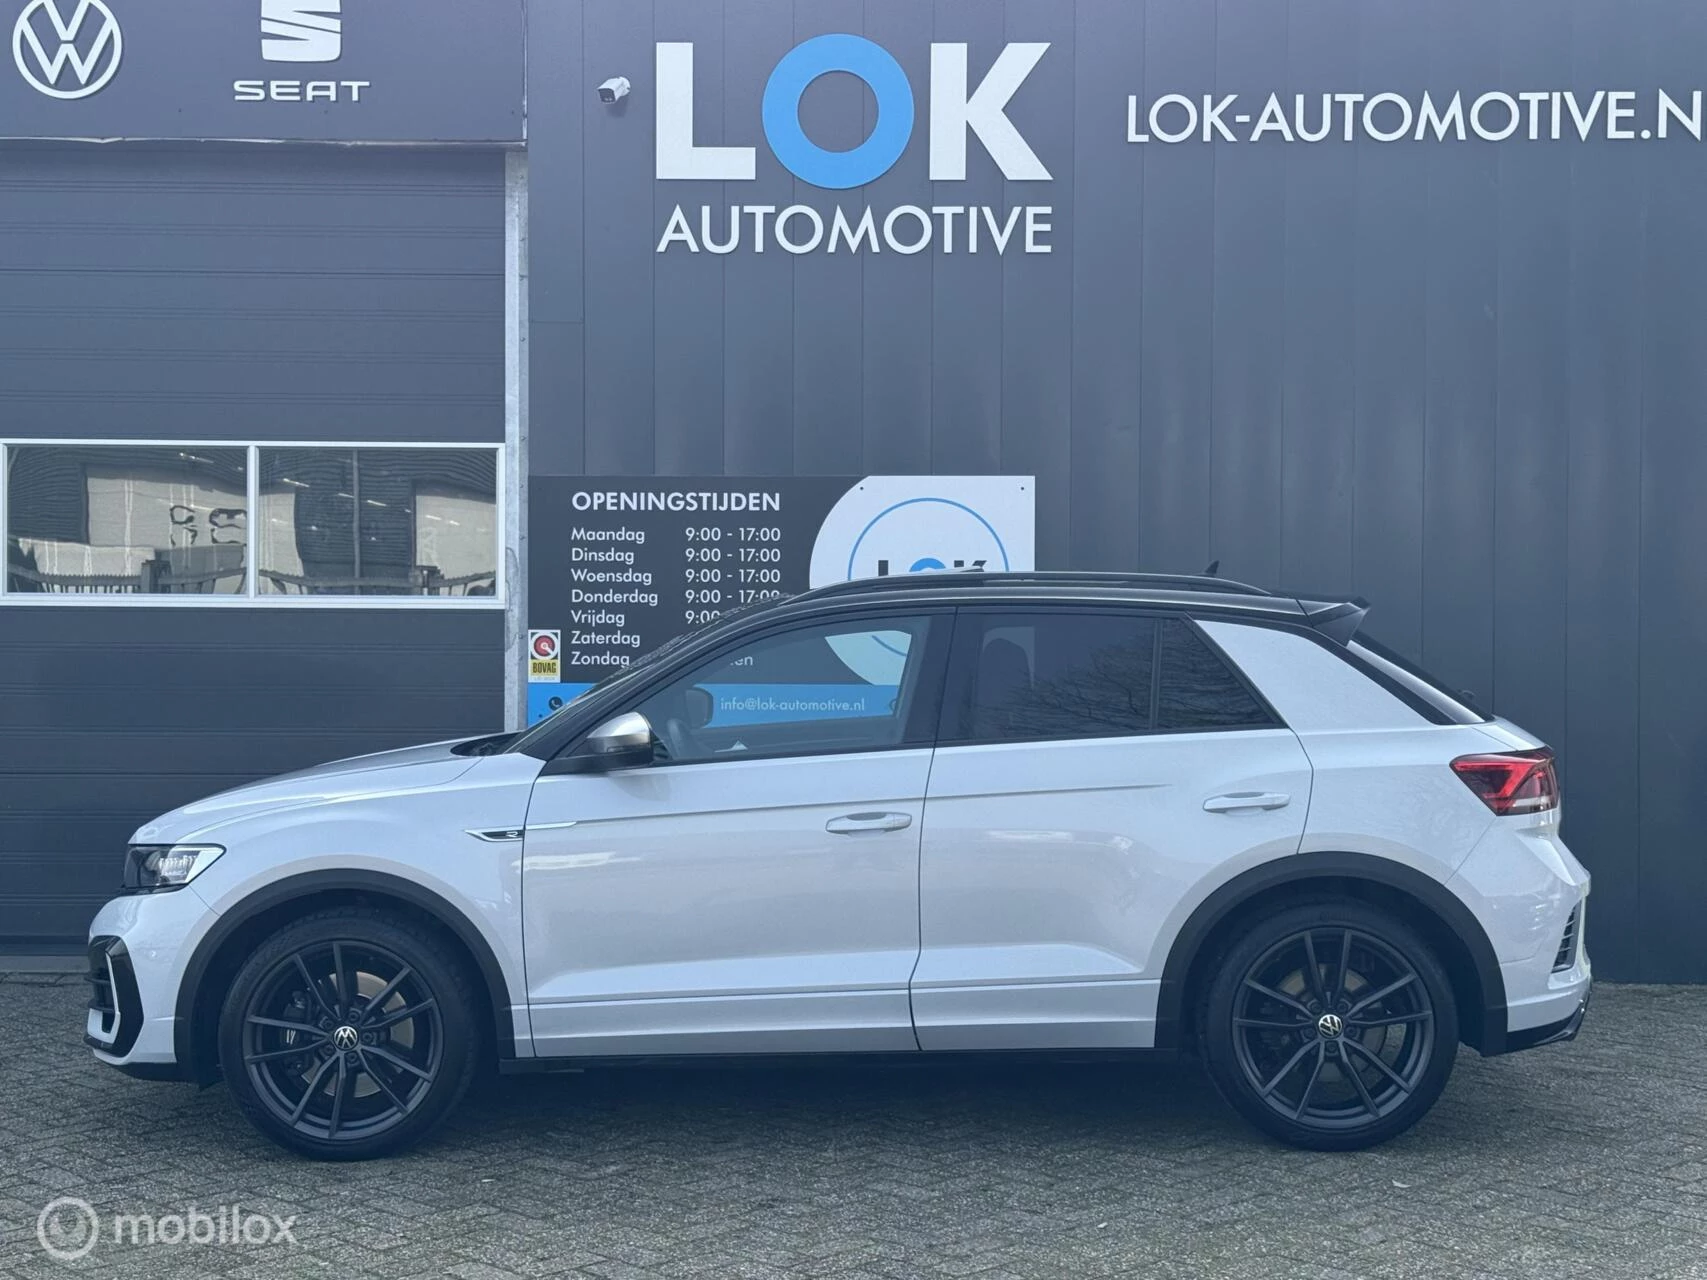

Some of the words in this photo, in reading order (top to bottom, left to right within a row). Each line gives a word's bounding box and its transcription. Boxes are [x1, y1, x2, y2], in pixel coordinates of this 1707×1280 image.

[233, 80, 370, 102] SEAT
[655, 33, 1053, 189] LOK
[656, 204, 1053, 255] AUTOMOTIVE
[571, 492, 781, 511] OPENINGSTIJDEN
[570, 526, 646, 544] Maandag
[684, 528, 721, 542] 9:00
[739, 528, 781, 542] 17:00
[570, 547, 635, 565] Dinsdag
[684, 548, 721, 562] 9:00
[739, 548, 781, 562] 17:00
[570, 568, 652, 585] Woensdag
[684, 569, 721, 583] 9:00
[739, 569, 781, 583] 17:00
[570, 589, 659, 607] Donderdag
[684, 589, 721, 603] 9:00
[570, 609, 626, 627] Vrijdag
[570, 630, 641, 648] Zaterdag
[532, 662, 557, 673] BOVAG
[570, 650, 630, 668] Zondag
[720, 697, 865, 711] info@lok-automotive.nl
